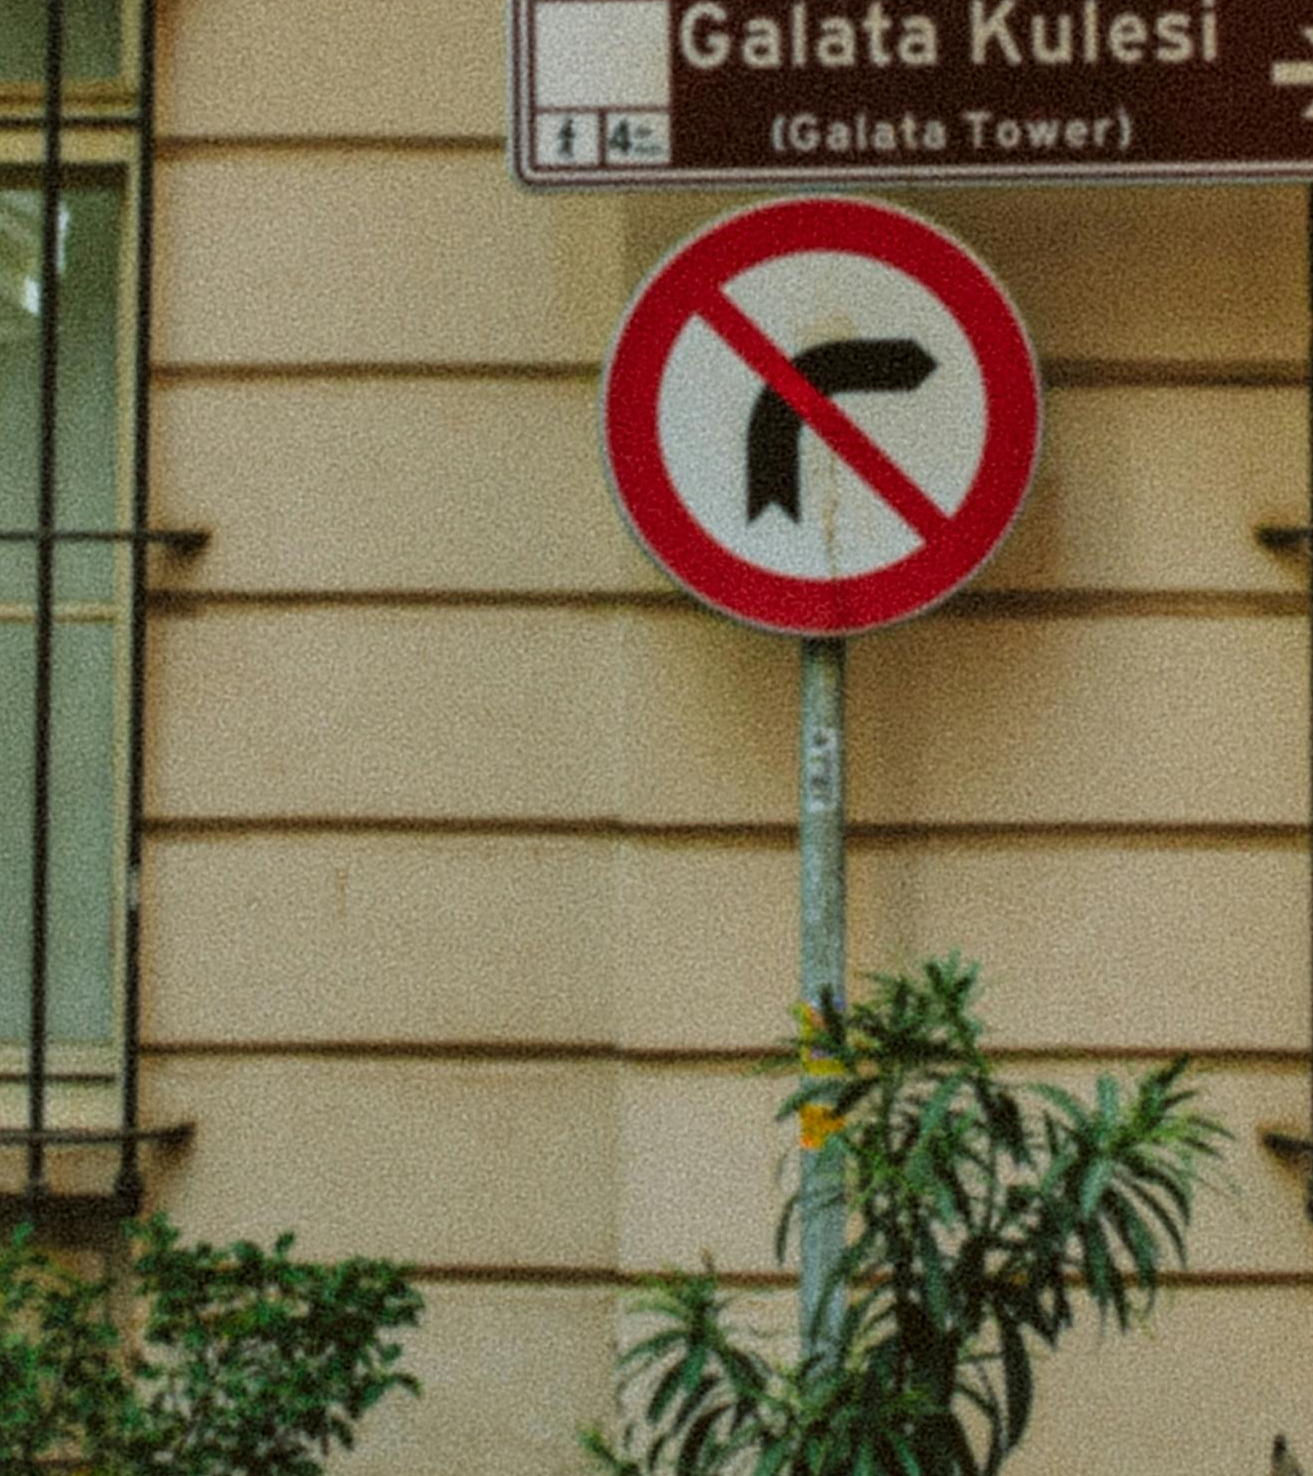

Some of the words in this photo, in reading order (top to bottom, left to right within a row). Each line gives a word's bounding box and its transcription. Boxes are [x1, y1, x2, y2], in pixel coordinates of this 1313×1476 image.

[680, 0, 938, 69] Galata
[770, 110, 947, 153] (Galata
[962, 105, 1133, 152] Tower)
